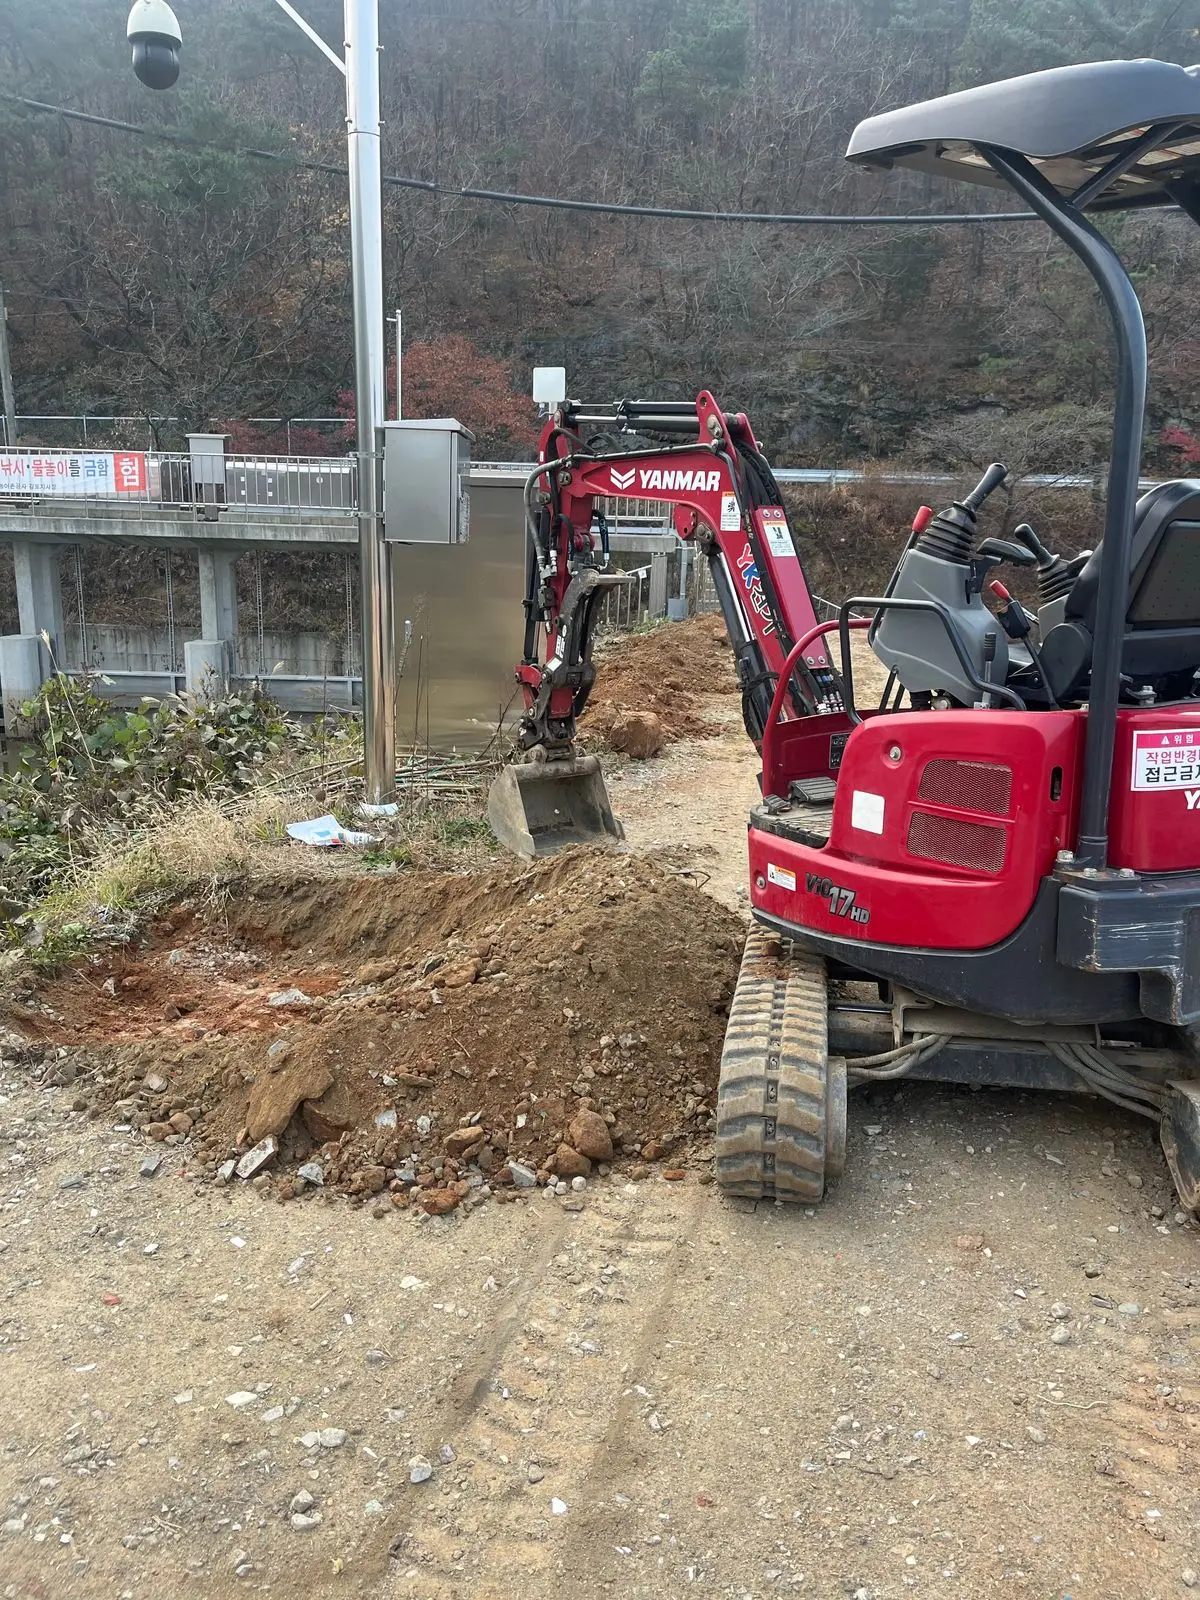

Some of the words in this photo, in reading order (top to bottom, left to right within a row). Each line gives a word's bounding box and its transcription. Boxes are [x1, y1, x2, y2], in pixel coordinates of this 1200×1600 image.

[85, 458, 109, 477] 금함
[119, 457, 139, 487] 험
[640, 470, 721, 491] YANMAR
[1146, 749, 1200, 764] 작업반경
